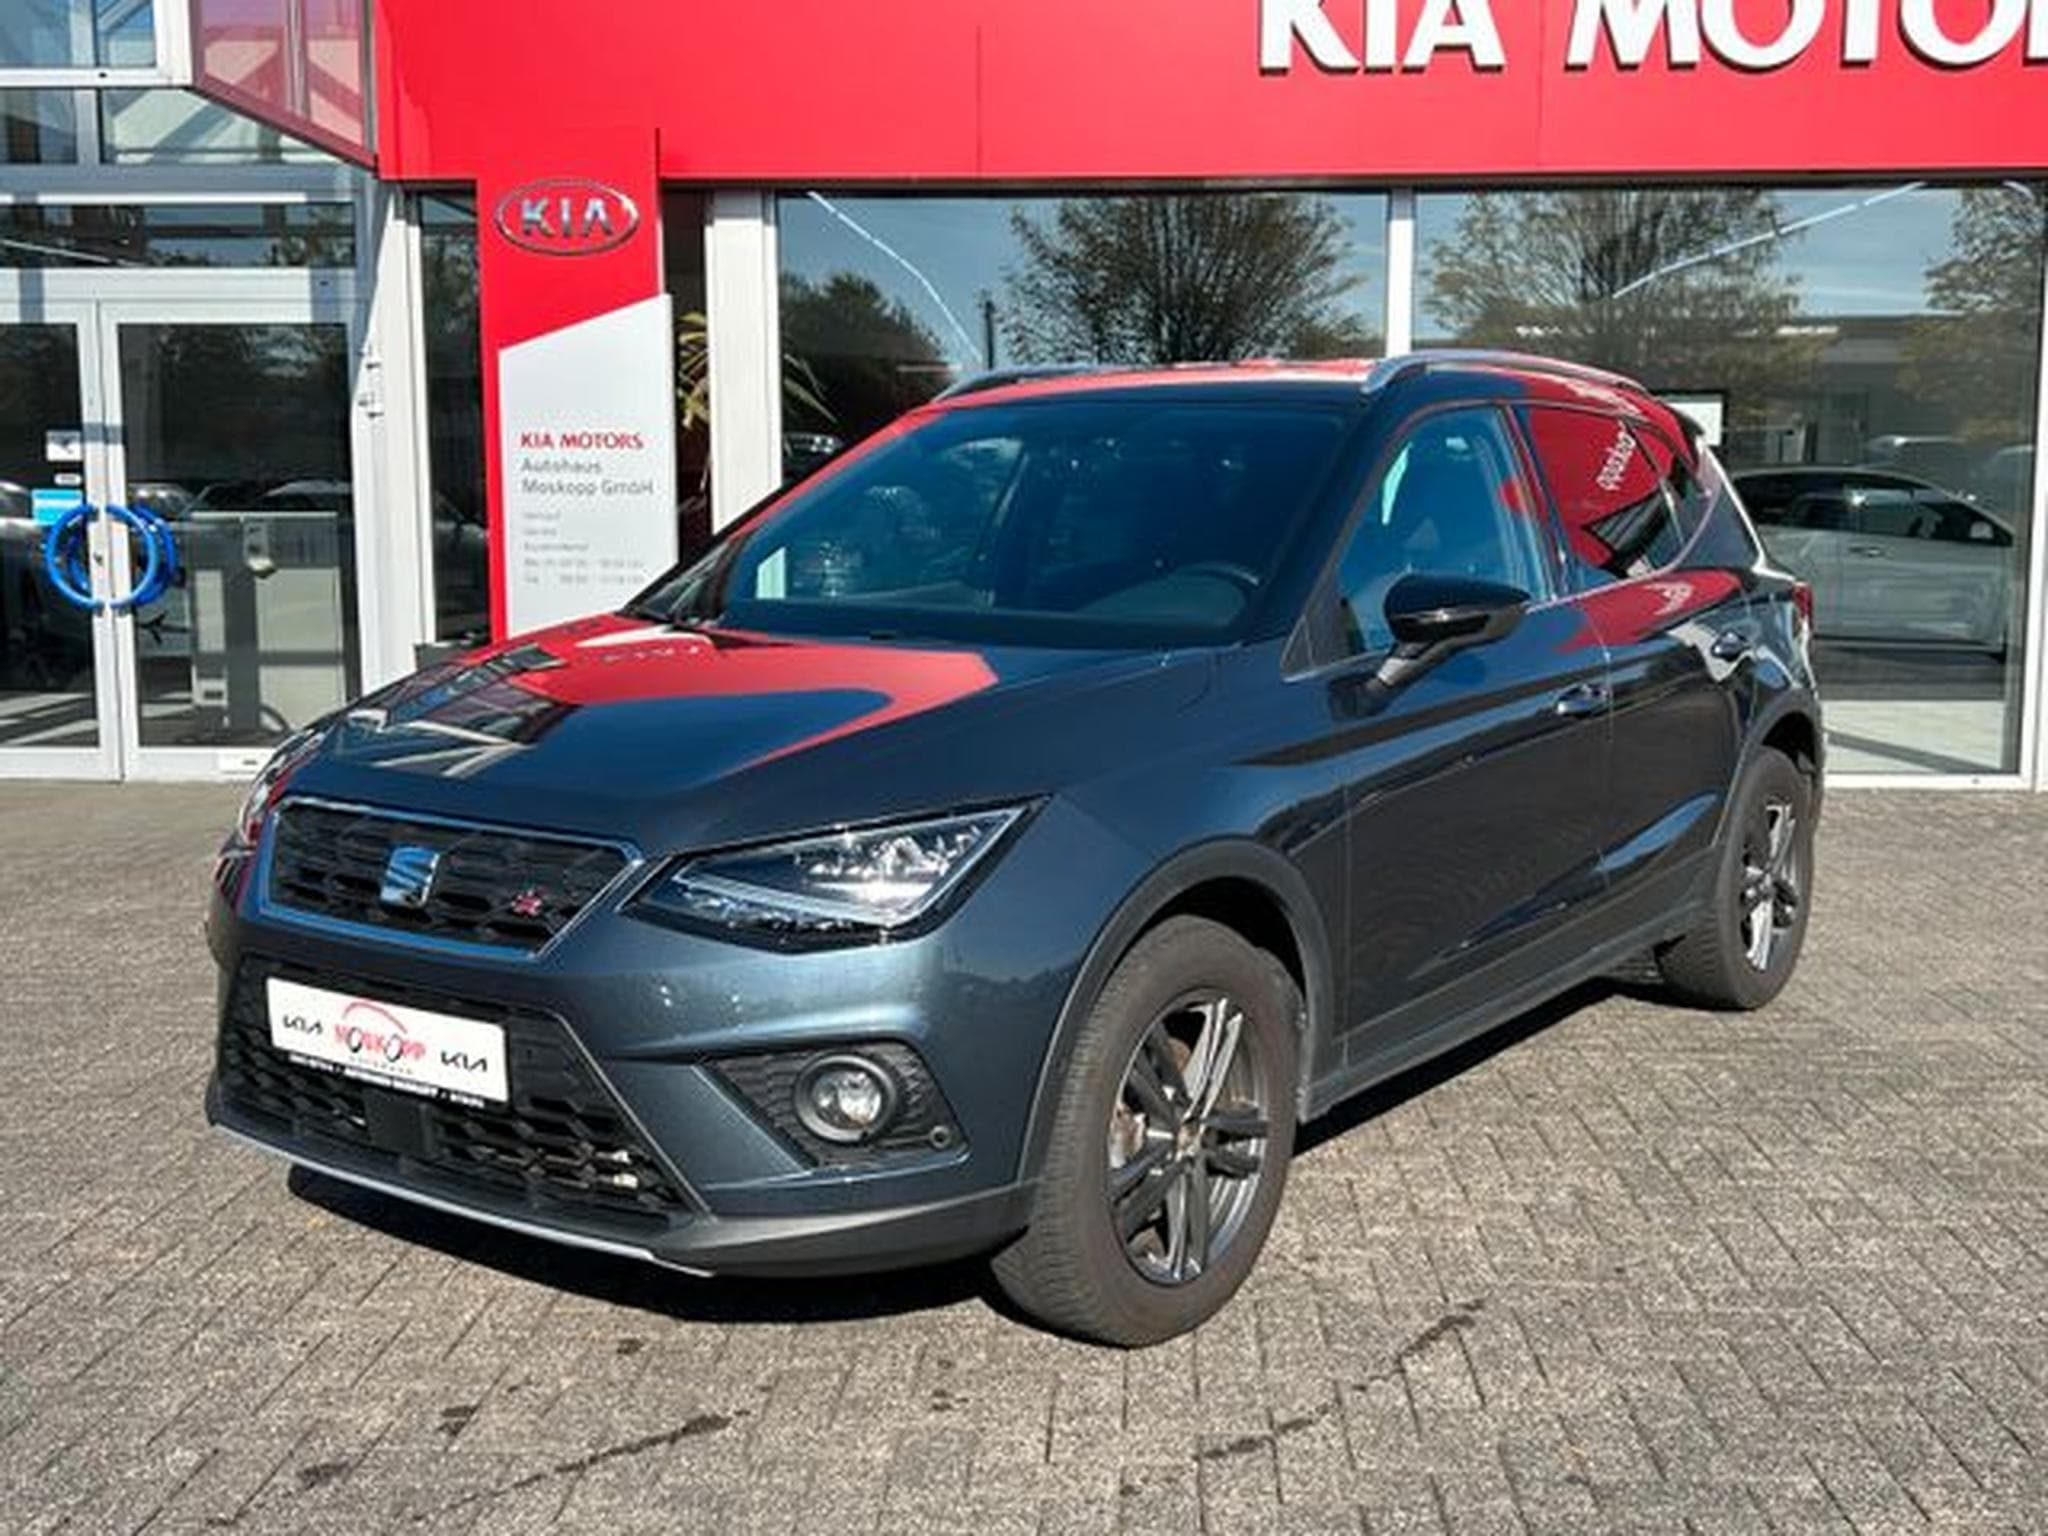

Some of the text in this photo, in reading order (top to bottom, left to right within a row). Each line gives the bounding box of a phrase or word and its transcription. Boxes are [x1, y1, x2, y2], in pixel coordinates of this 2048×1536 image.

[1259, 0, 2048, 74] KIA MOTO
[522, 198, 613, 237] KIA
[521, 431, 645, 449] KIA MOTORS
[520, 458, 602, 474] Autohaus
[521, 477, 654, 496] Moskopp GmbH
[283, 1013, 324, 1036] KIA
[441, 1050, 488, 1073] KIA
